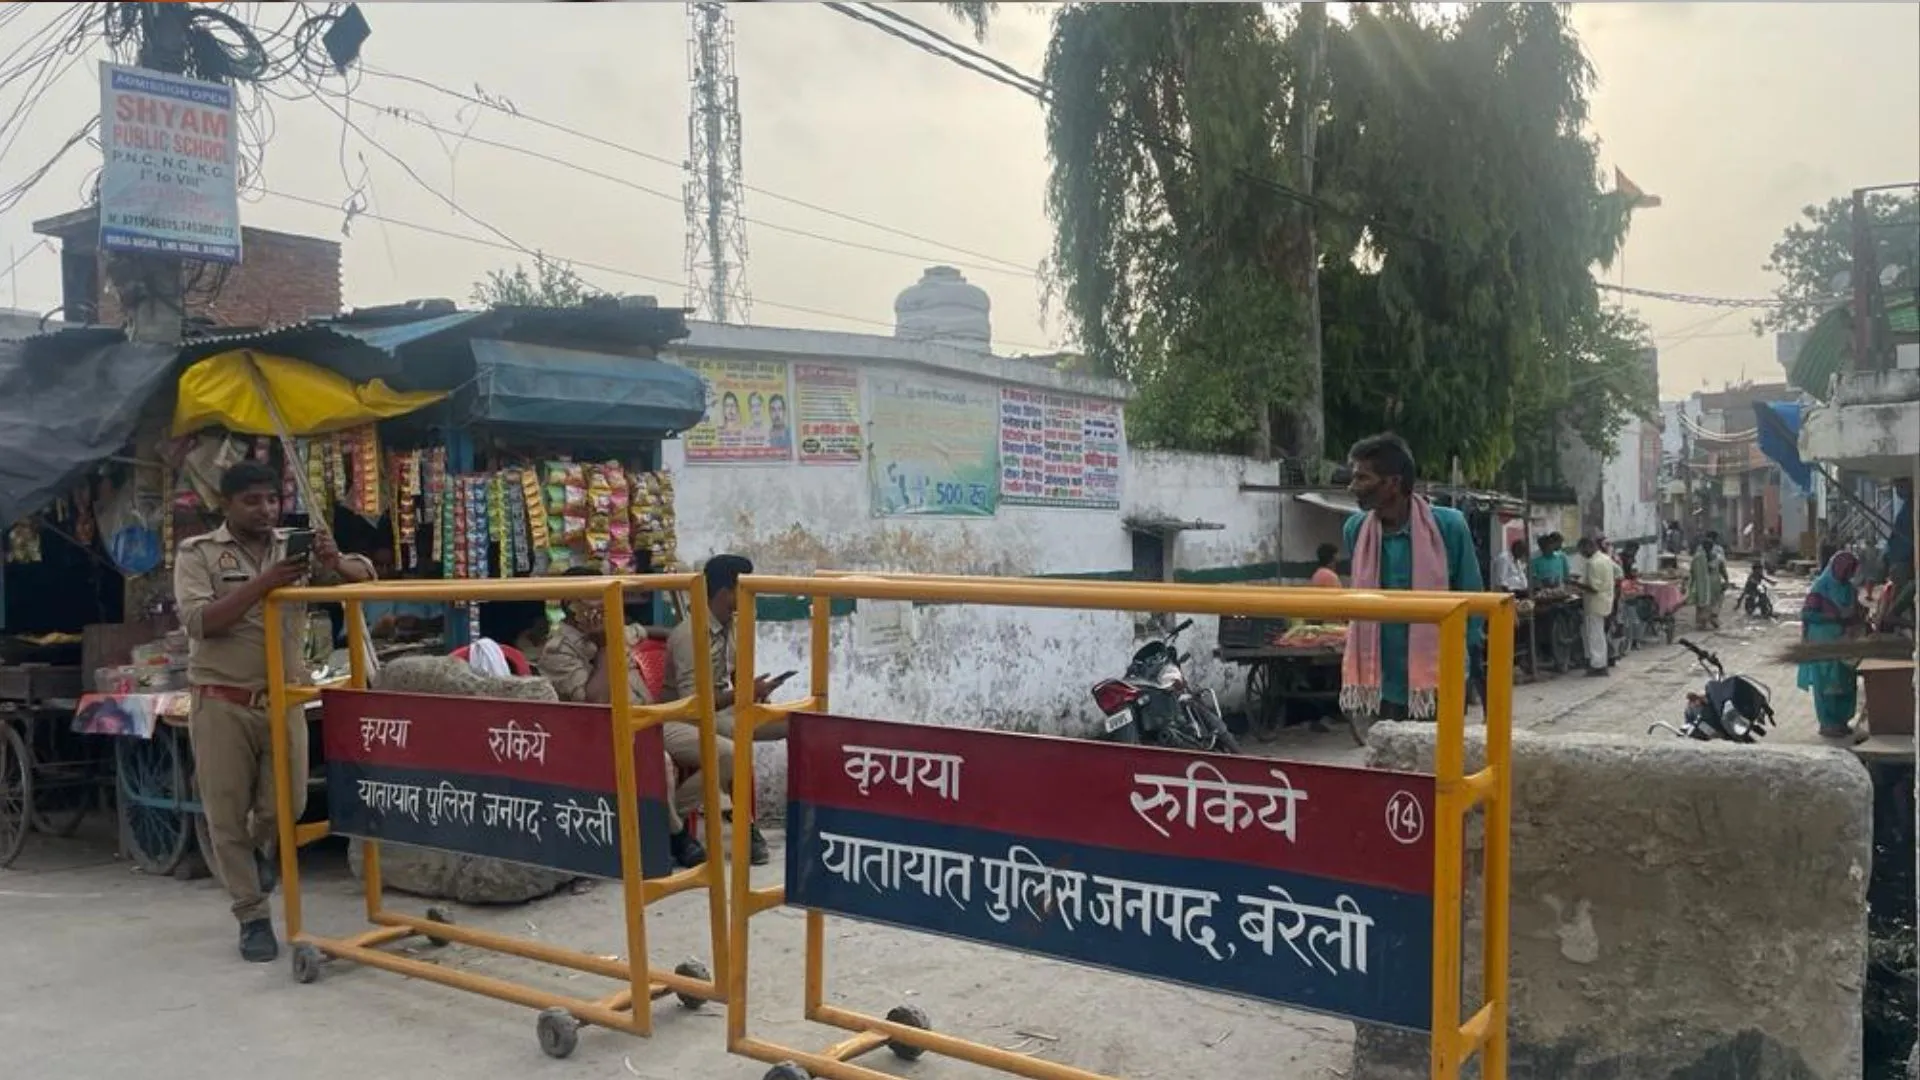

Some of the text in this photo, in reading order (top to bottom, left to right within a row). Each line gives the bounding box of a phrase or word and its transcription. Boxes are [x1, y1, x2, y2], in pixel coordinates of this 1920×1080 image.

[115, 75, 229, 105] ADMISSION OPEN
[115, 94, 229, 139] SHYAM
[113, 123, 230, 164] PUBLIC SCHOOL
[156, 171, 172, 183] to
[937, 481, 963, 505] 500
[360, 717, 551, 766] कृपया रुकिये
[357, 780, 422, 823] यातायात
[426, 780, 477, 828] पुलिस
[553, 798, 616, 846] बरेली
[842, 745, 1417, 843] कृपया रुकिये 14
[819, 831, 975, 910] यातायात
[980, 845, 1088, 931] पुलिस
[1238, 885, 1375, 976] बरेली
